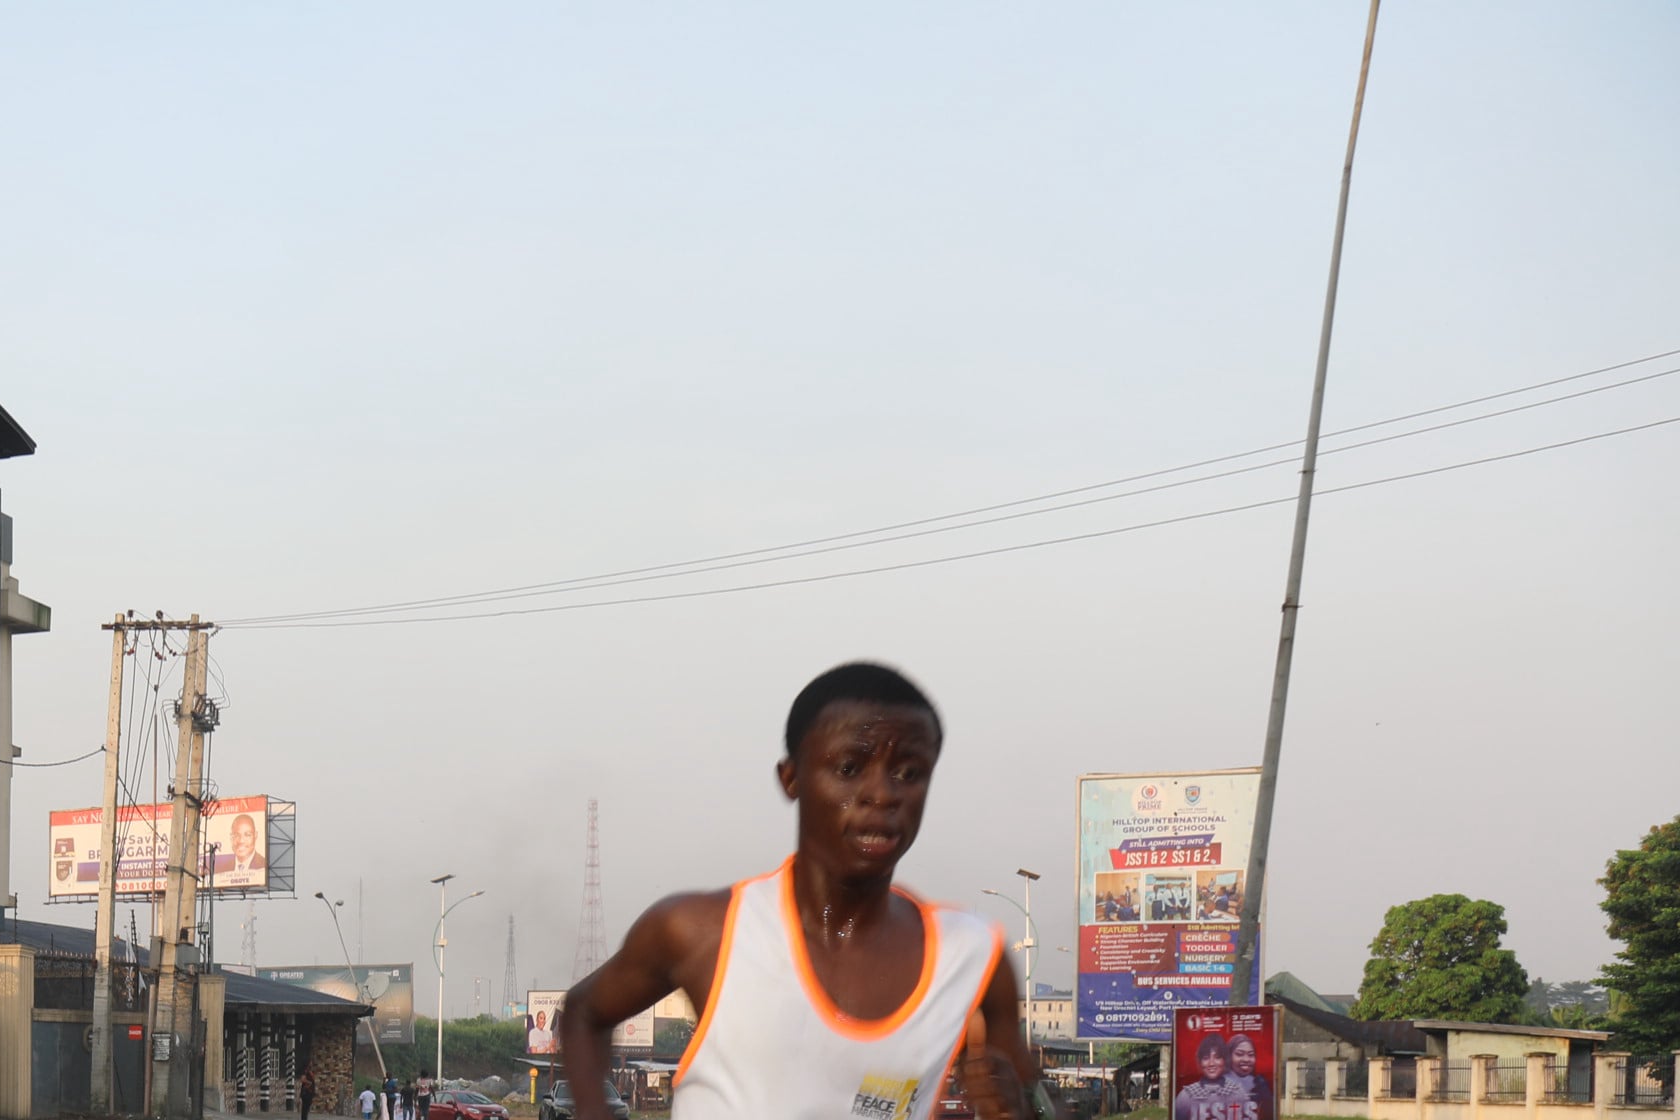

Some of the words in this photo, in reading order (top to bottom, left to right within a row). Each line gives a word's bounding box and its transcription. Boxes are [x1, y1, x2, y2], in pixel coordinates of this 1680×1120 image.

[73, 815, 88, 824] SAY
[1112, 817, 1150, 826] HILLTOP
[1152, 816, 1227, 825] INTERNATIONAL
[1122, 826, 1155, 834] GROUP
[1157, 825, 1170, 833] OF
[1172, 824, 1216, 832] SCHOOLS
[1129, 840, 1146, 848] STILL
[1148, 839, 1186, 847] ADMITTING
[1187, 838, 1204, 846] INTO
[1125, 852, 1148, 866] JSS1
[1160, 852, 1167, 864] 2
[1172, 850, 1191, 863] SS1
[1203, 850, 1210, 862] 2
[121, 861, 152, 870] INSTANT
[120, 870, 140, 878] YOUR
[1098, 926, 1138, 934] FEATURES
[1185, 944, 1228, 952] TODDLER
[1185, 954, 1226, 962] NURSERY
[1138, 976, 1153, 985] BUS
[1157, 976, 1190, 985] SERVICES
[1191, 976, 1230, 985] AVAILABLE
[854, 1093, 896, 1113] PEACE
